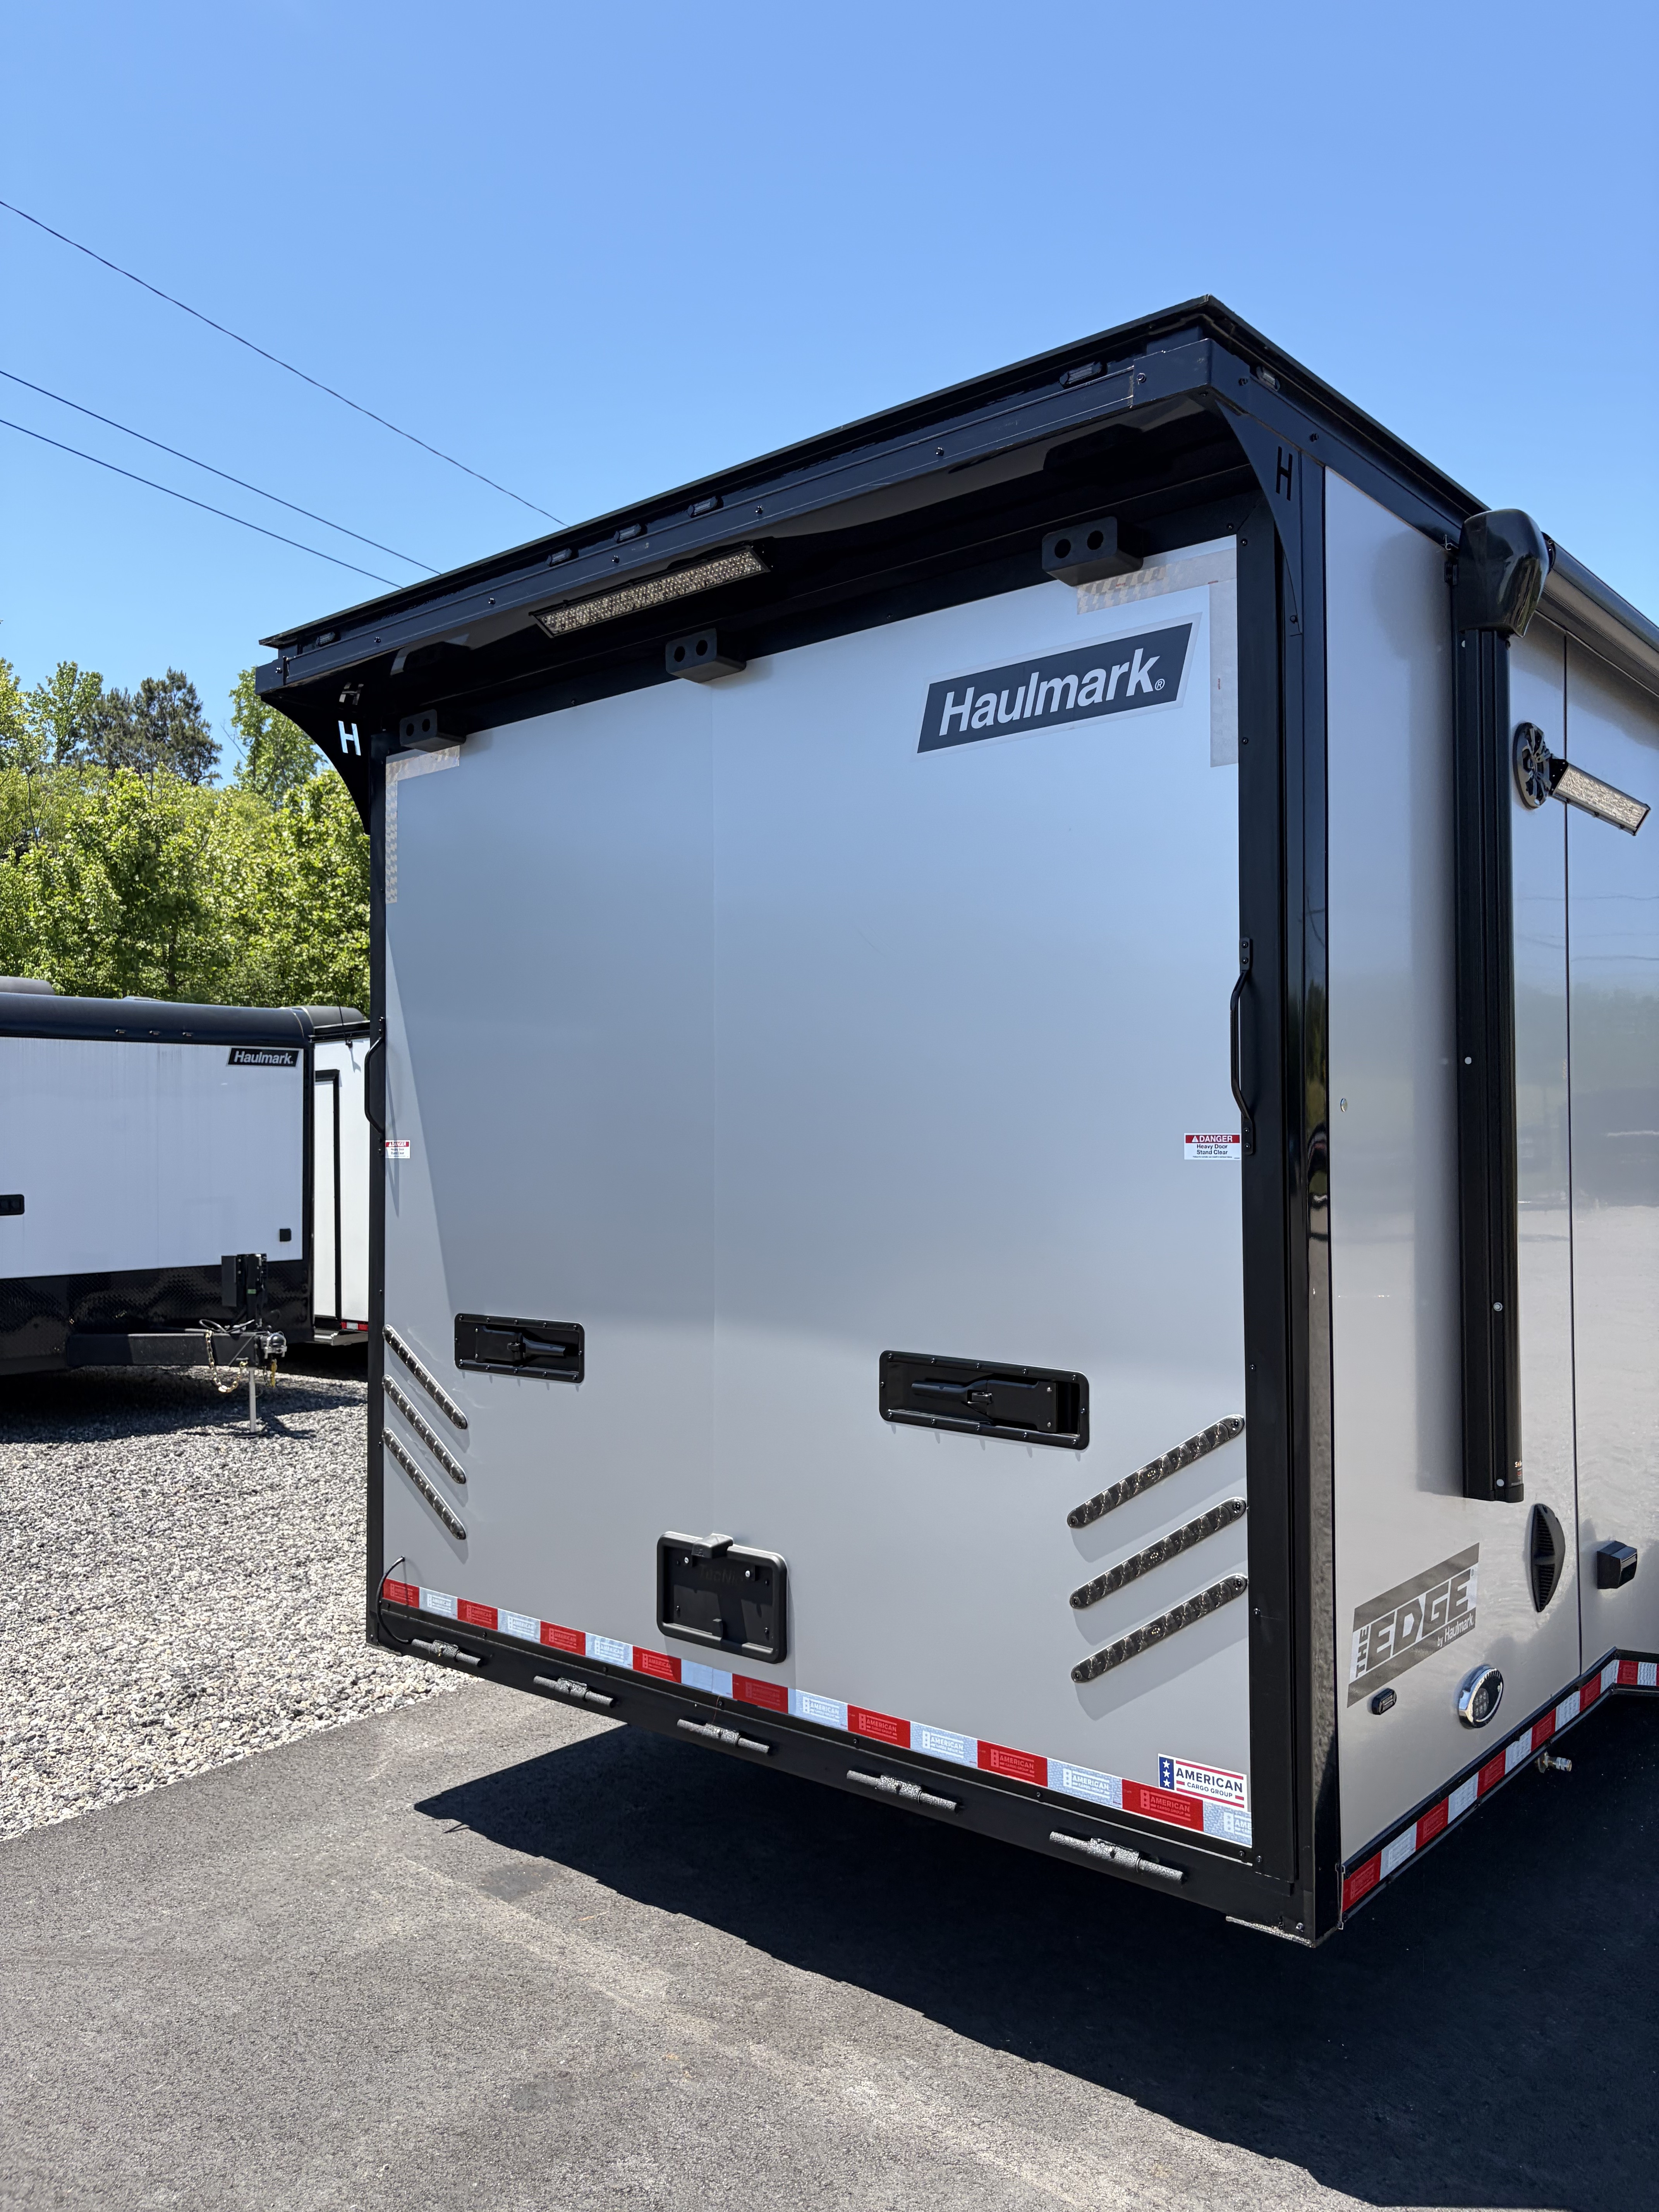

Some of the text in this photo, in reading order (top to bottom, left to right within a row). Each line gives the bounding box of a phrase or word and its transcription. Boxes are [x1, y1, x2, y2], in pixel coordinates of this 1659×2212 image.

[1365, 1568, 1471, 1672] EDGE
[1437, 1613, 1474, 1647] by Haulmark
[1355, 1625, 1370, 1678] THE
[866, 1719, 896, 1732] AMERICAN
[931, 1737, 963, 1750] AMERICAN
[1000, 1755, 1034, 1769] AMERICAN
[1072, 1775, 1109, 1790] AMERICAN
[1176, 1767, 1243, 1793] AMERICAN
[1187, 1782, 1233, 1798] CARGO GROUP
[1150, 1796, 1190, 1813] AMERICAN
